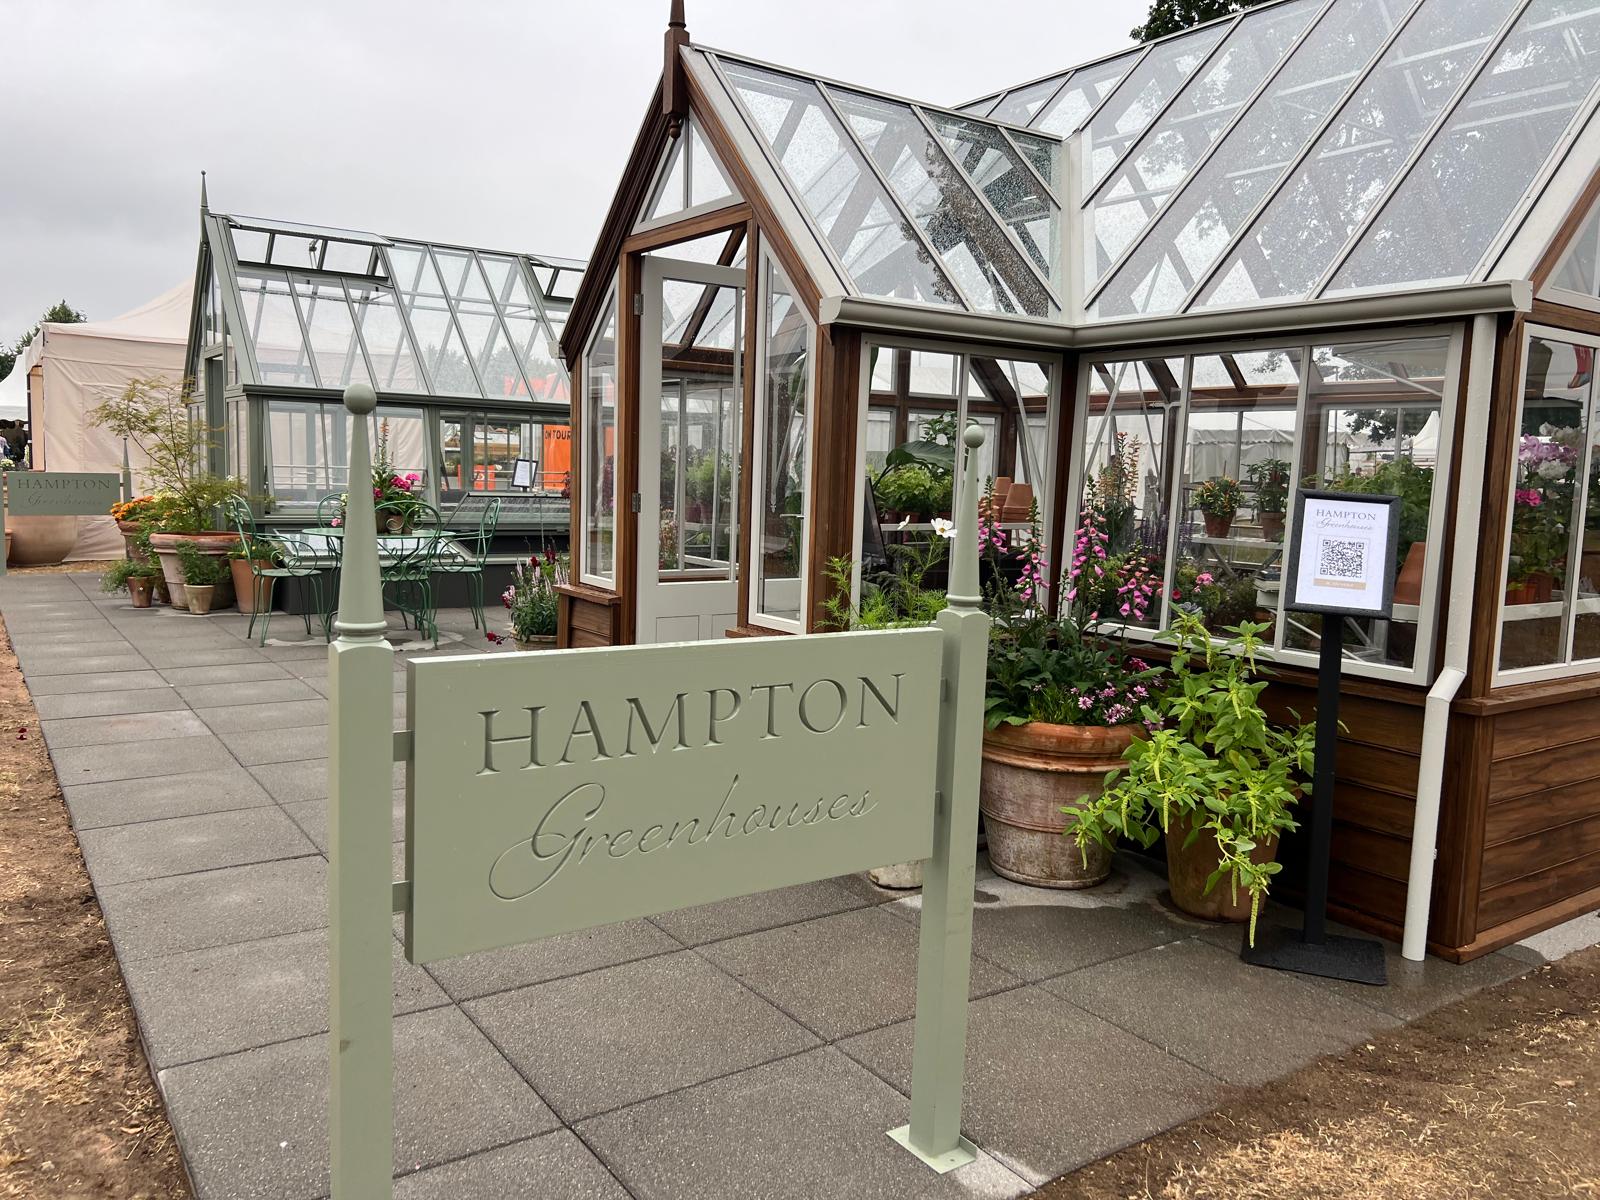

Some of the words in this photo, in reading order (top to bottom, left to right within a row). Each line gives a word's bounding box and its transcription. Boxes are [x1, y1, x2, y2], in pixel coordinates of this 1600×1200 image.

[18, 479, 111, 489] HAMPTON
[1316, 508, 1377, 521] HAMPTON
[1316, 517, 1374, 531] Greenhouses
[476, 672, 907, 777] HAMPTON
[488, 773, 879, 902] Greenhouses
